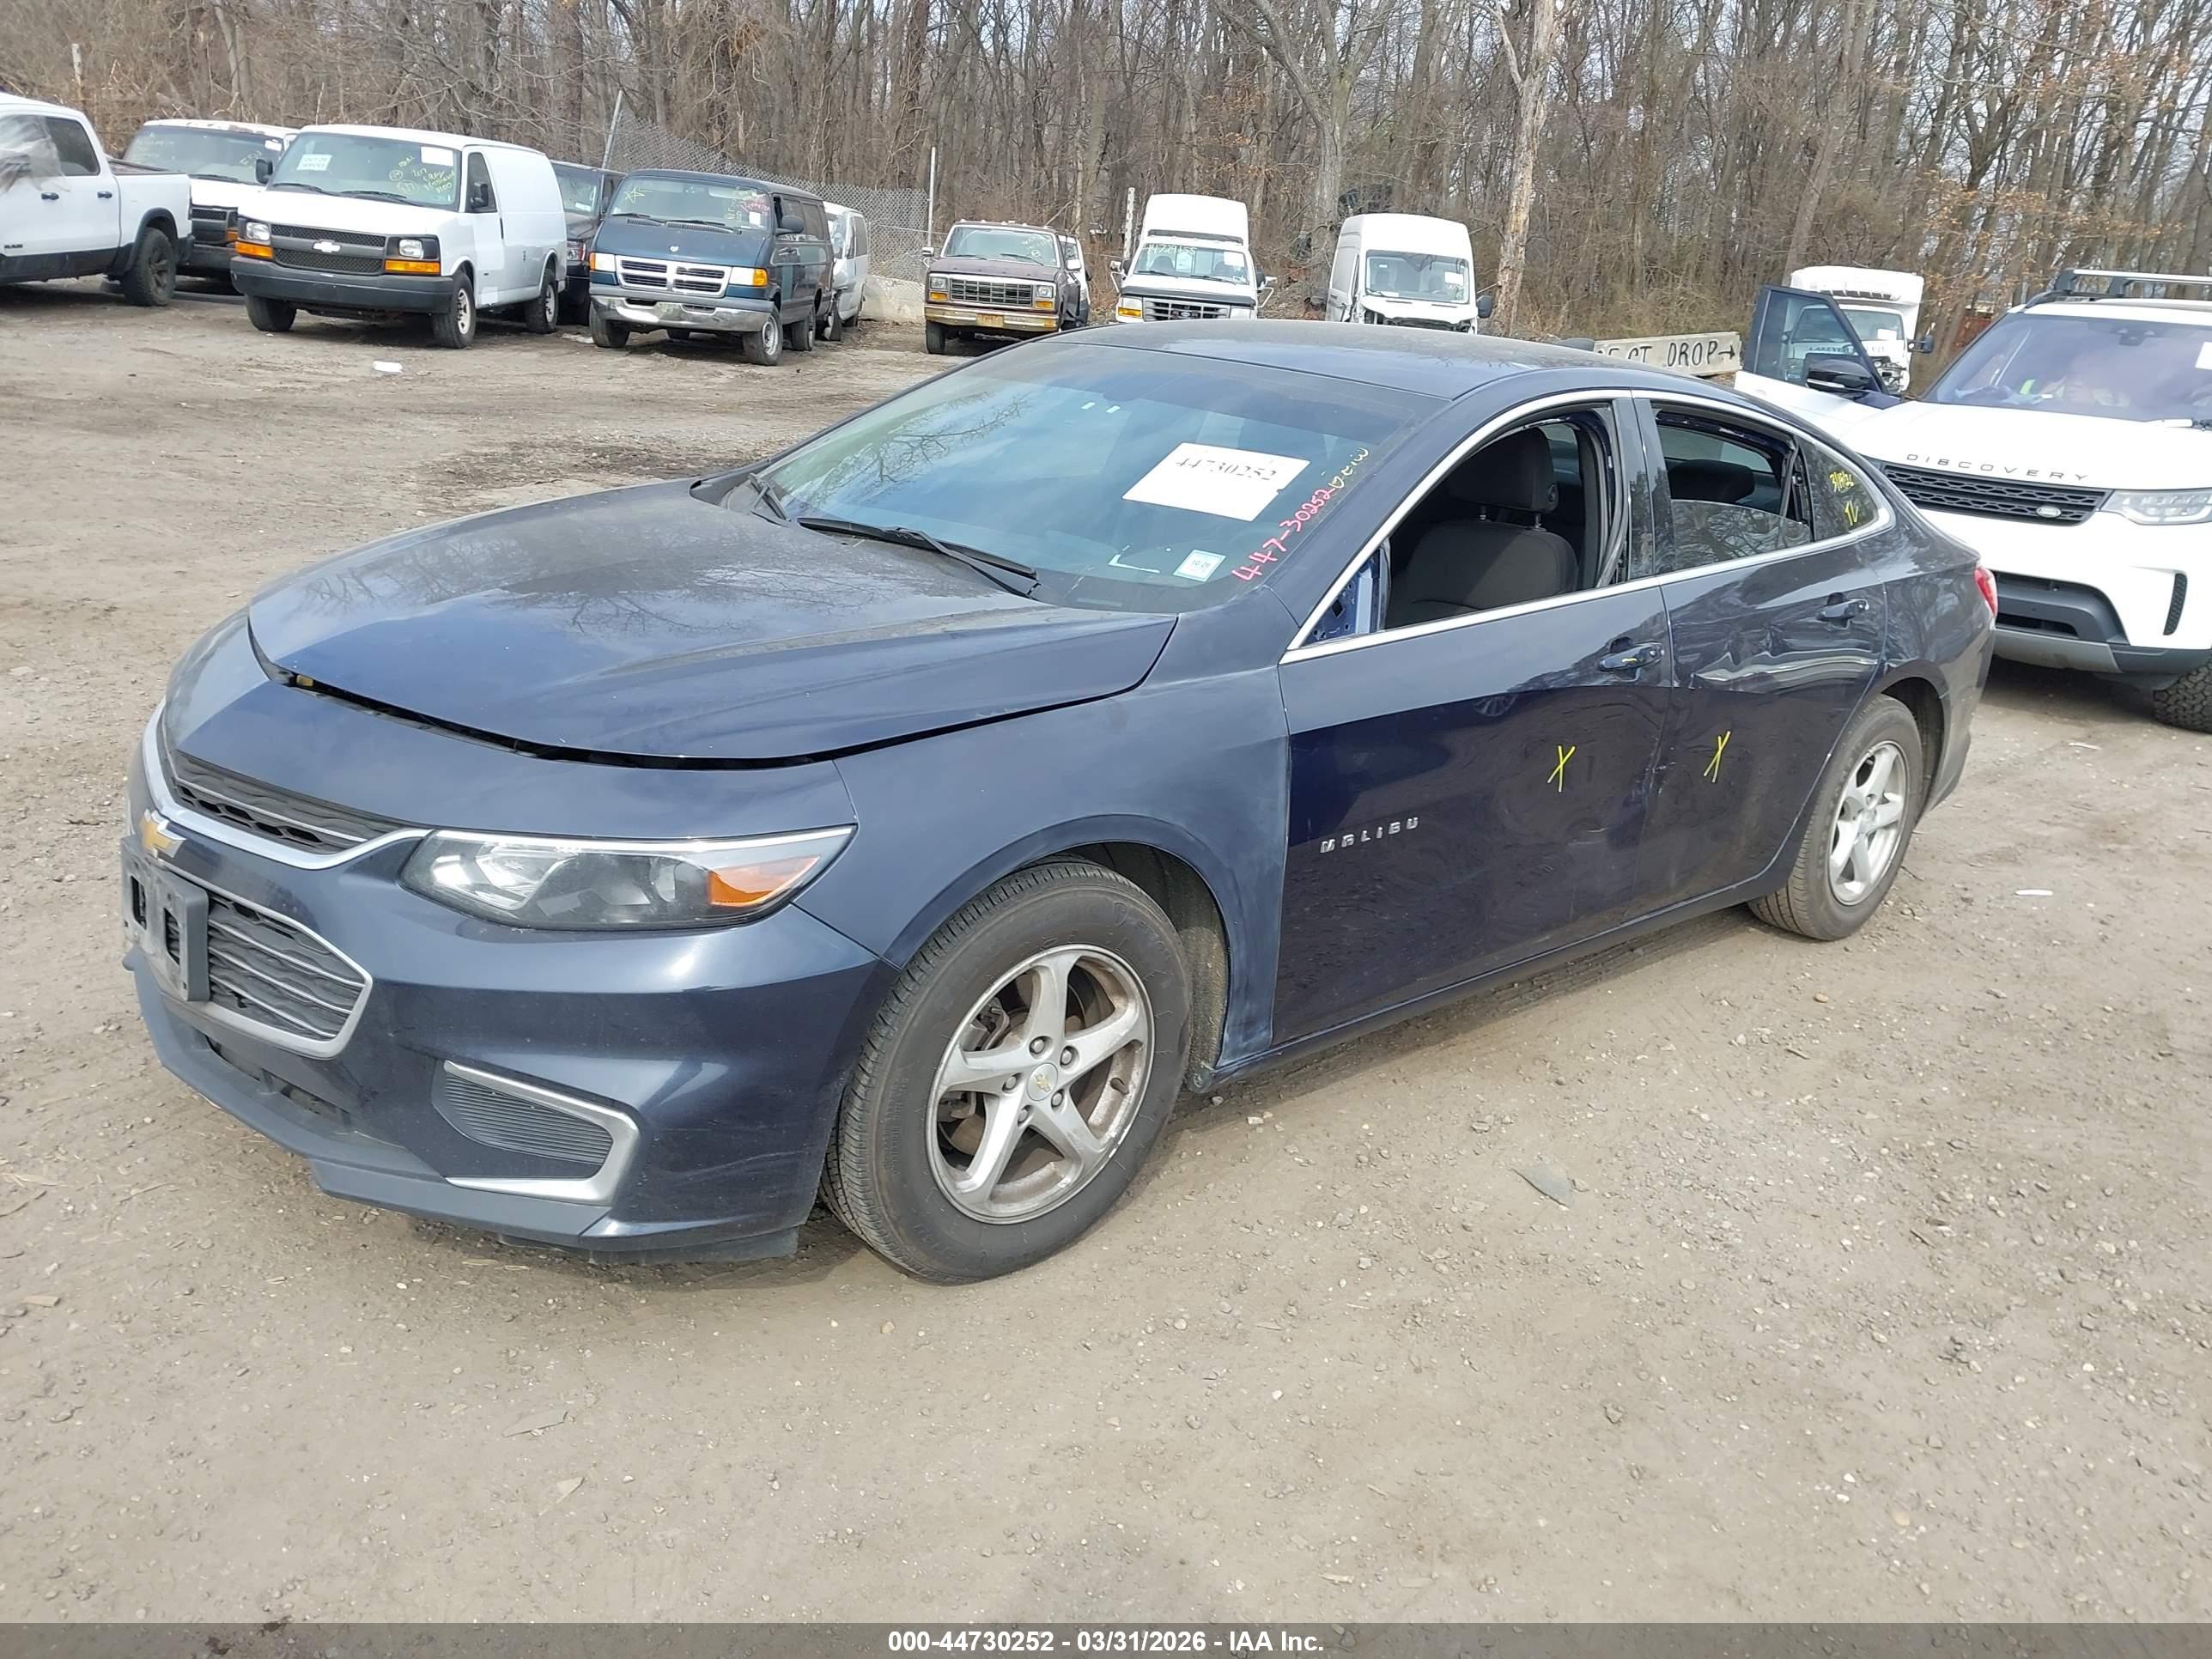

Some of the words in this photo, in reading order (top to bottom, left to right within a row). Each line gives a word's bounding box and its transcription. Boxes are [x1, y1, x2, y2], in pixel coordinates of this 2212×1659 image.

[1667, 340, 1717, 368] DROP
[1176, 458, 1277, 481] 44730252
[1905, 453, 2089, 481] DISCOVERY
[1231, 488, 1336, 581] 447-30252
[1320, 817, 1419, 854] MALIBU
